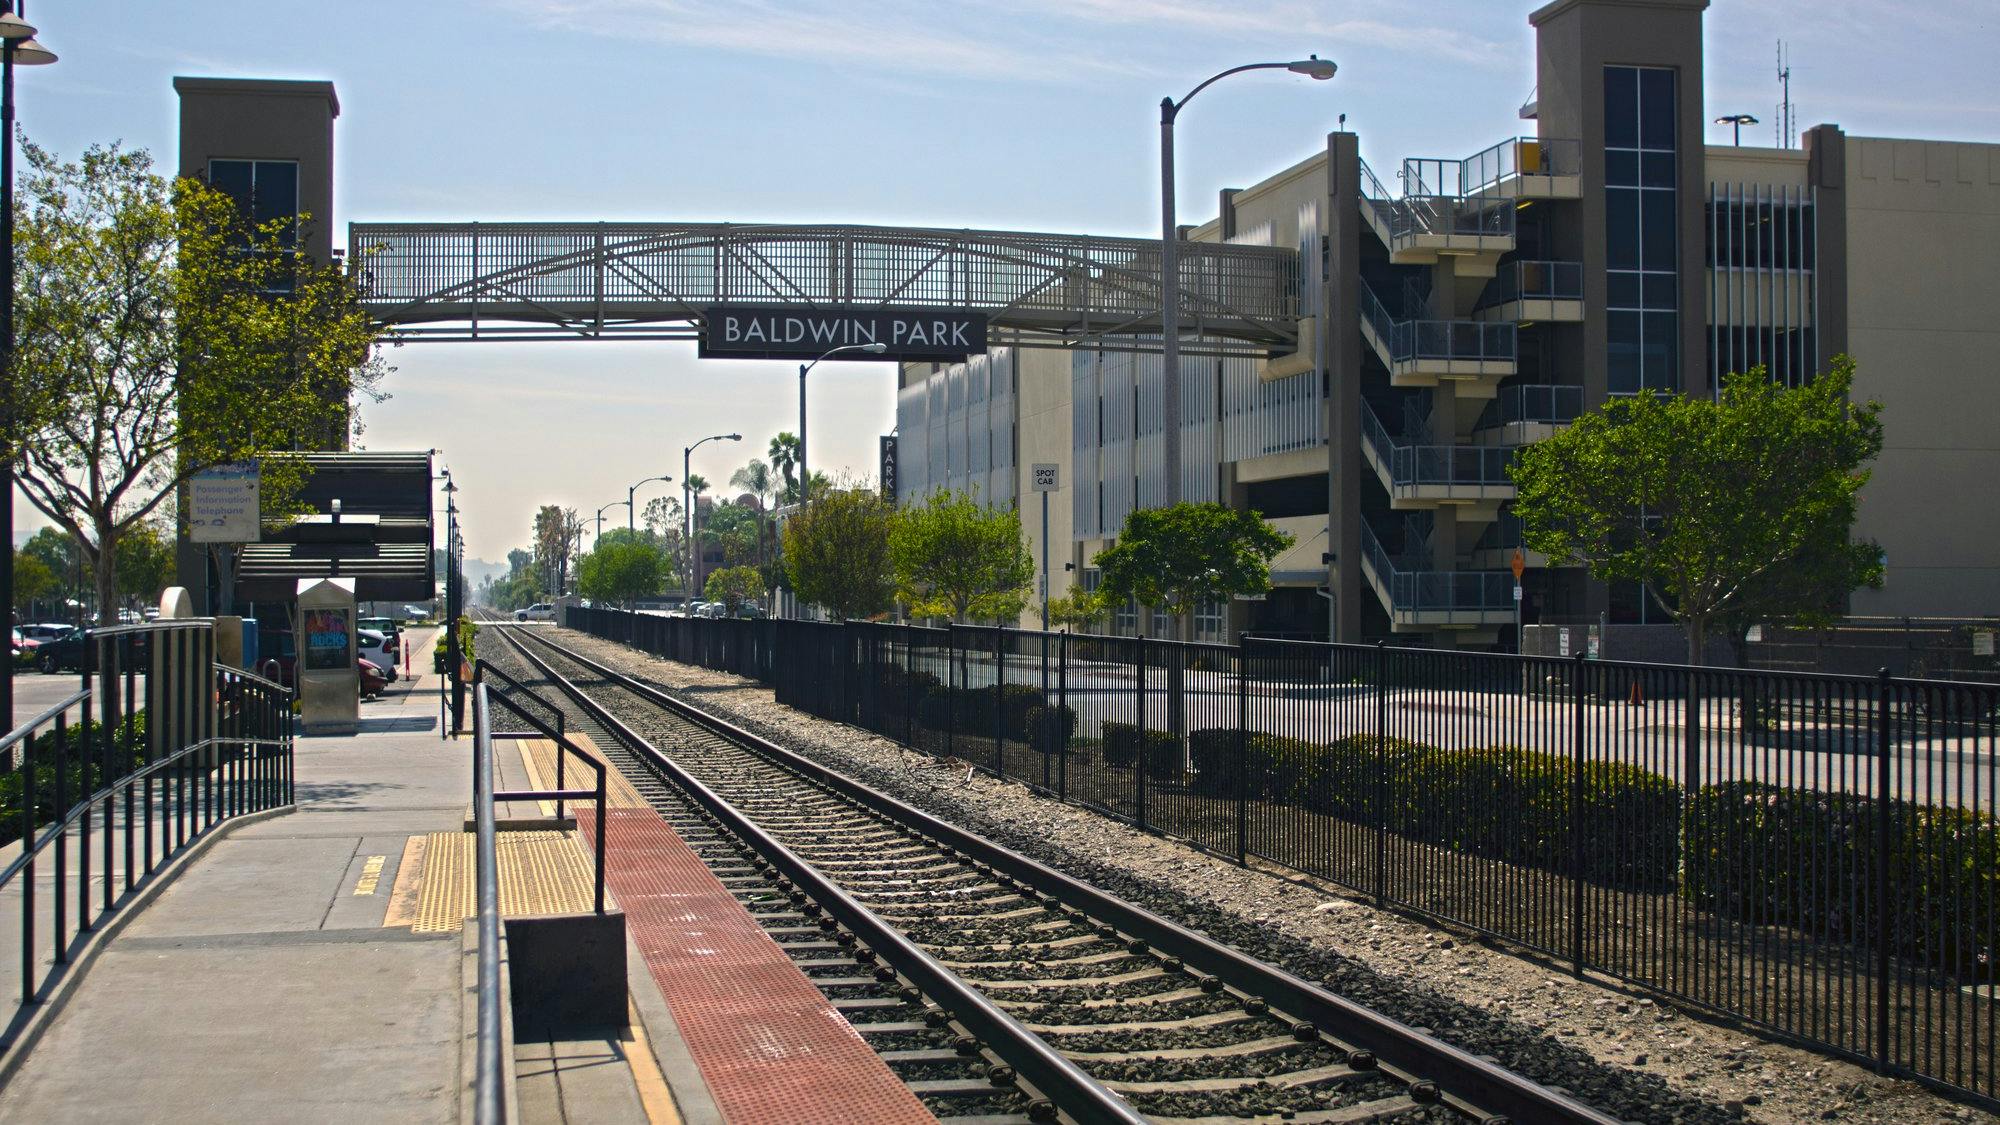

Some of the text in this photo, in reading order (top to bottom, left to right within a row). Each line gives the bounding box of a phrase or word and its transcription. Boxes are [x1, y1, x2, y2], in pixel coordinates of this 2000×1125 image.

[726, 316, 970, 347] BALDWIN PARK
[885, 440, 894, 489] PARK
[1036, 469, 1055, 477] SPOT
[1037, 477, 1053, 485] CAB
[196, 485, 243, 495] Passenger
[196, 496, 251, 504] Information
[197, 506, 243, 516] Telephone
